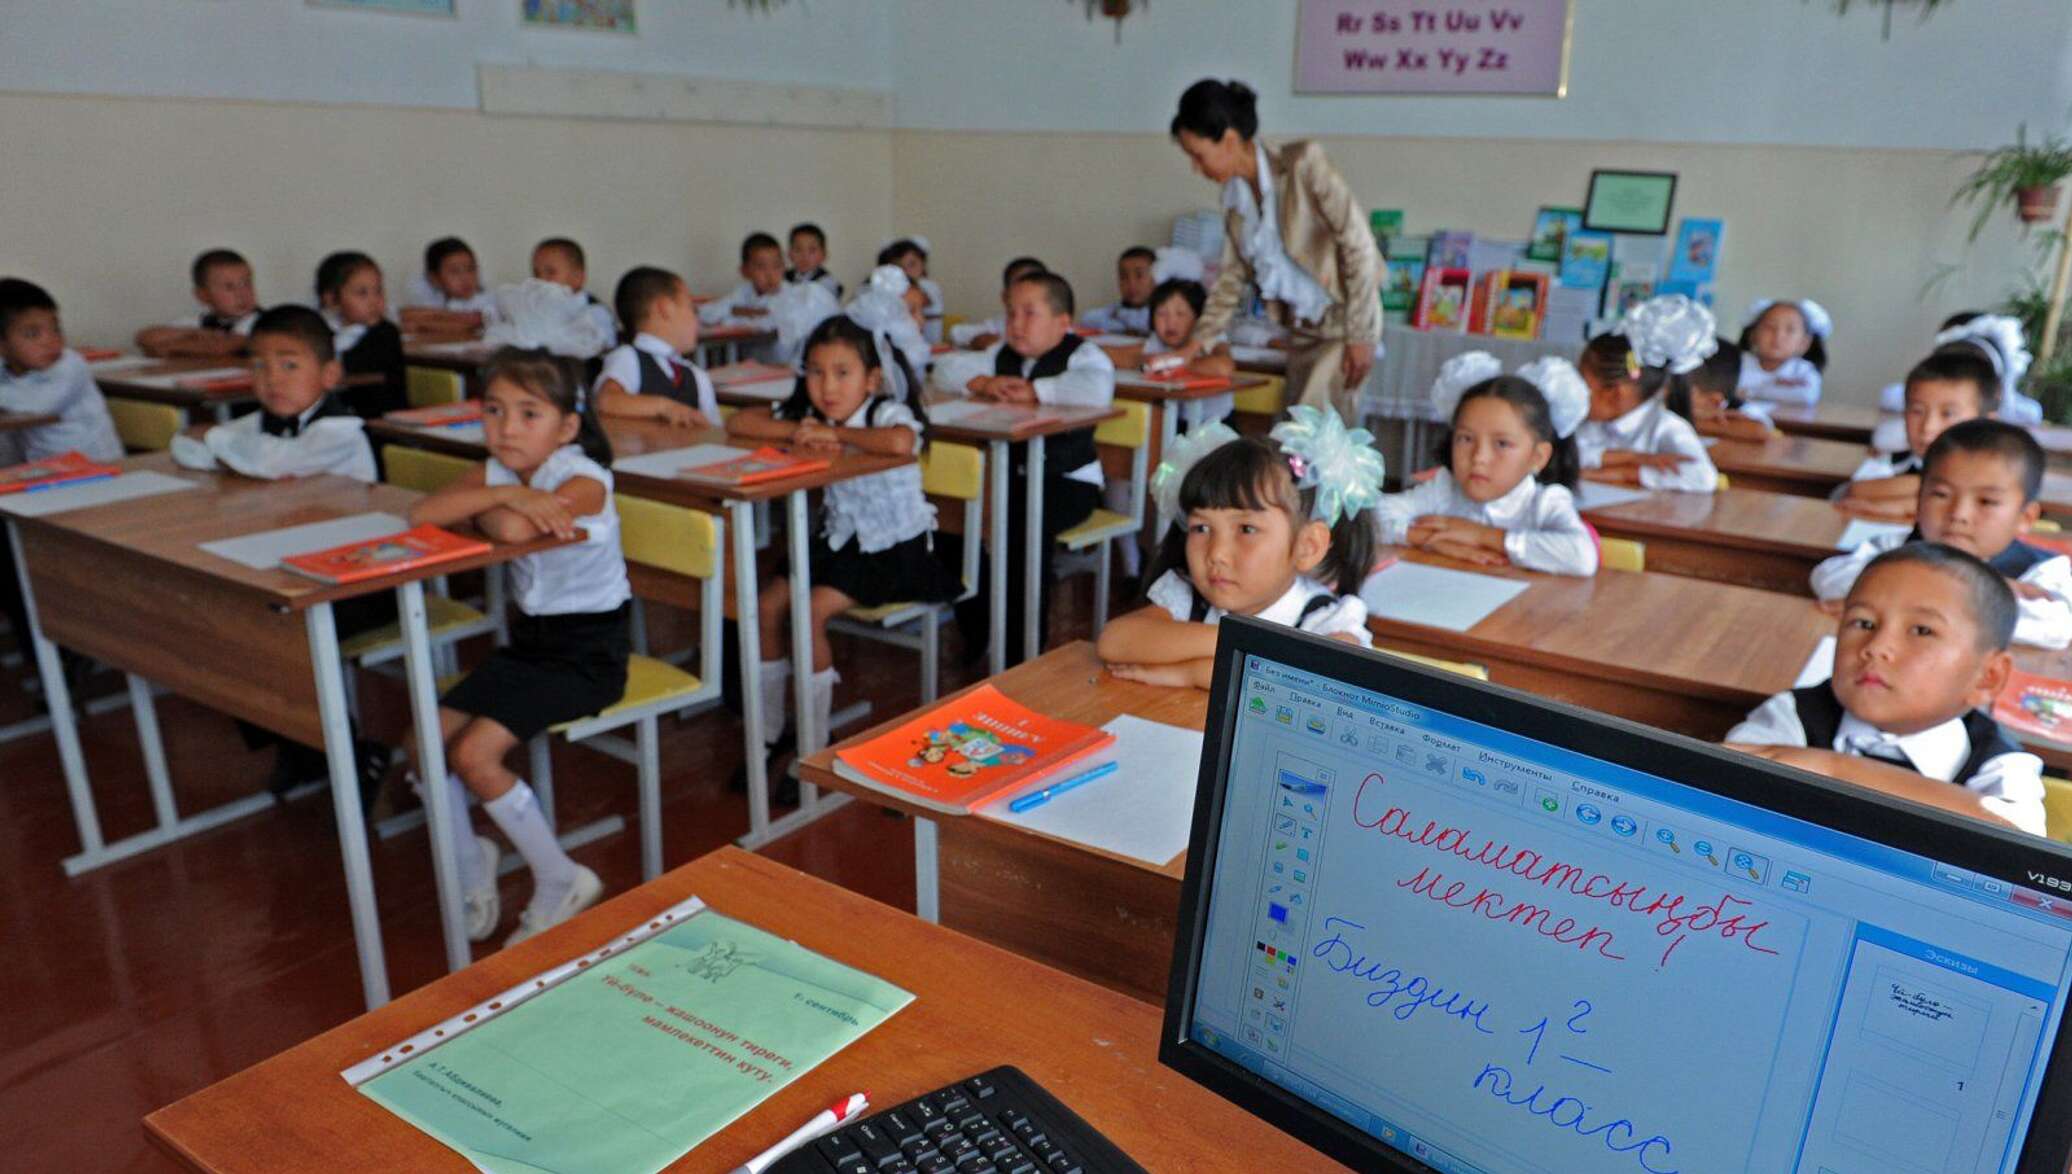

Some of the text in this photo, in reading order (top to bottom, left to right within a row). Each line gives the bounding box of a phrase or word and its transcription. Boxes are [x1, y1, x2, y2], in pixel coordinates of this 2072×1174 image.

[1337, 8, 1524, 34] Rr Ss Tt Uu Vv
[1343, 48, 1508, 75] Ww Xx Yy Zz
[1322, 683, 1360, 702] Блокнот
[1253, 681, 1620, 803] Файл Правка Вид Вставка Формат Инструменты Справка
[1397, 867, 1624, 960] мектеп
[1313, 917, 1495, 1034] Биздин
[1922, 948, 1979, 976] Эскизы
[1474, 1063, 1679, 1174] класс
